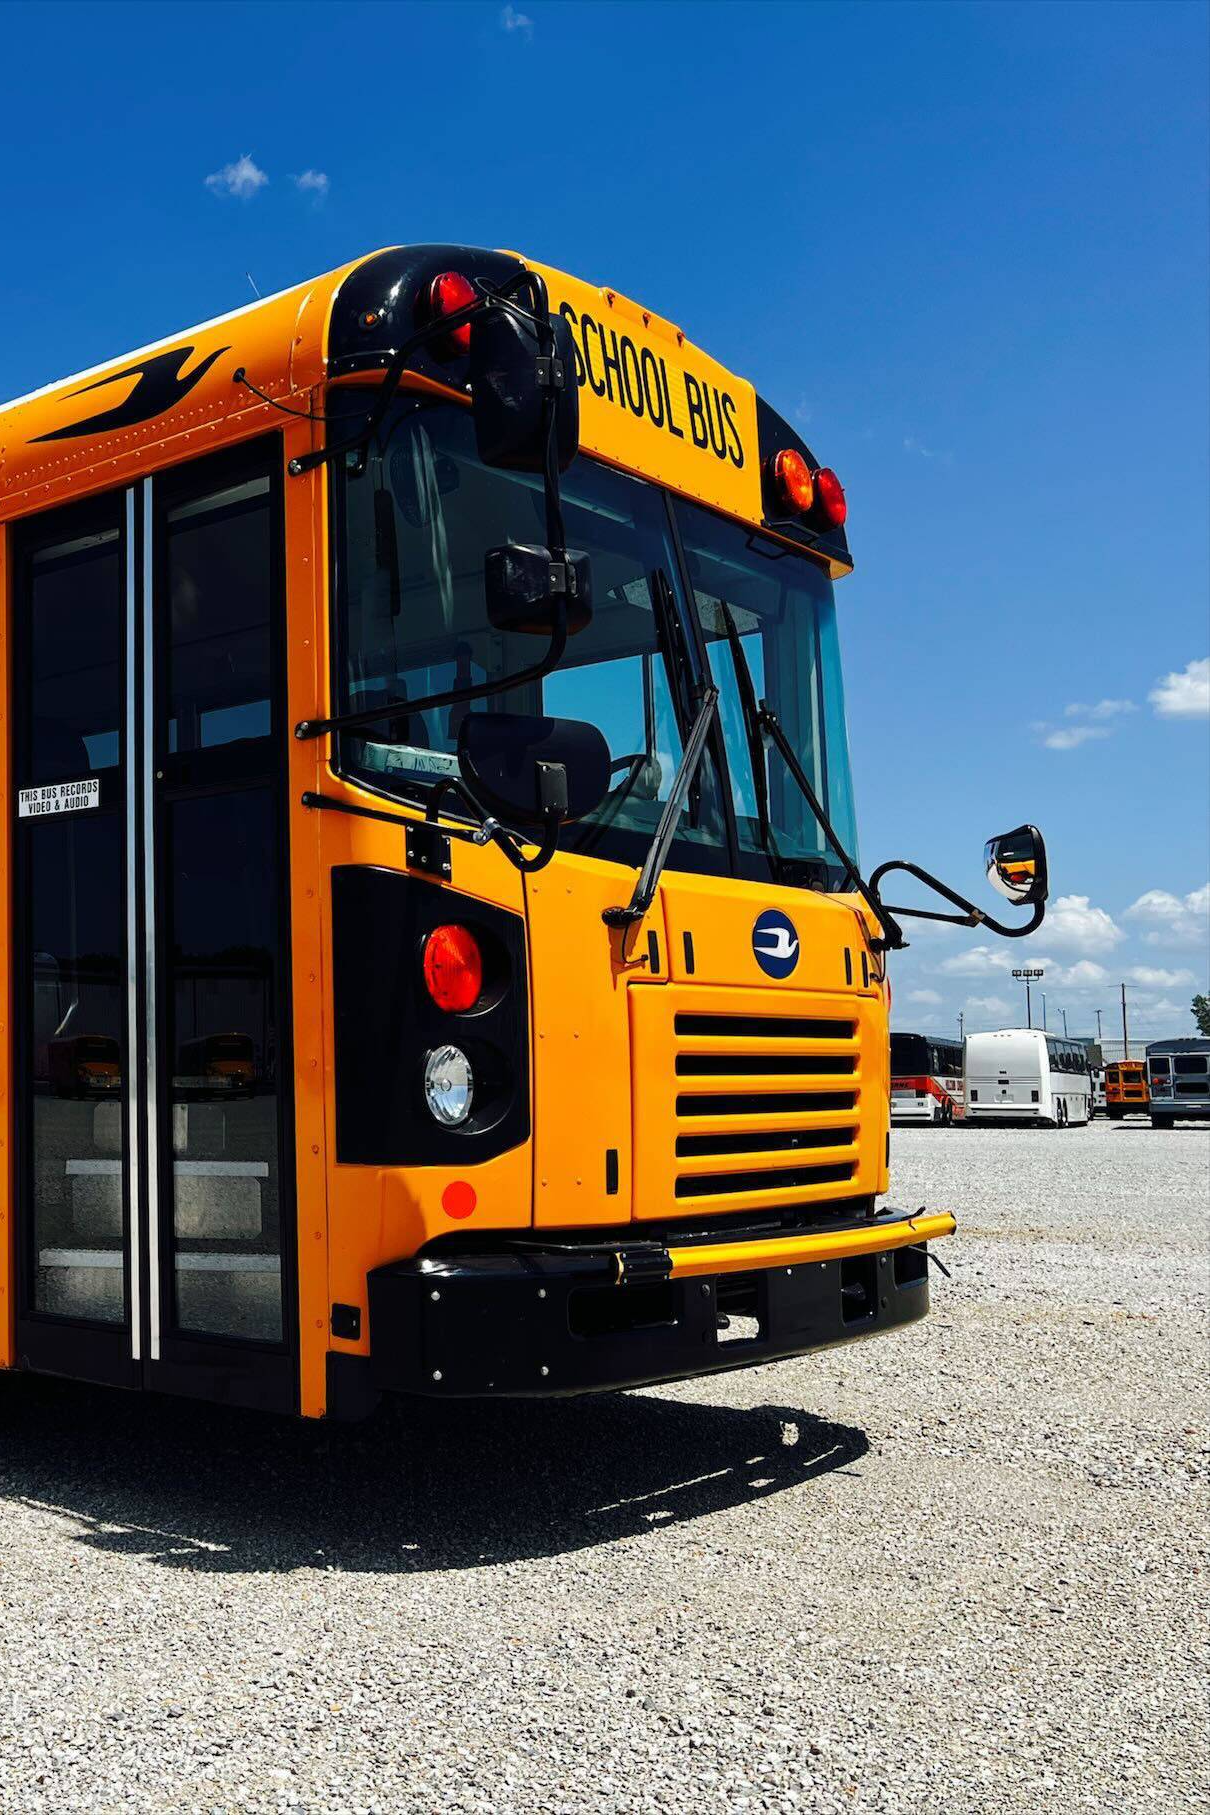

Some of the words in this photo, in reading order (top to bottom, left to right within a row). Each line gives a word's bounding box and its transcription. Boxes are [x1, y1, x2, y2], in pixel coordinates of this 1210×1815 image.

[559, 301, 684, 439] SCHOOL
[684, 371, 744, 469] BUS
[20, 790, 37, 802] THIS
[41, 787, 57, 800] BUS
[60, 781, 98, 797] RECORDS
[28, 800, 51, 814] VIDEO
[54, 799, 60, 811] &
[64, 795, 89, 810] AUDIO
